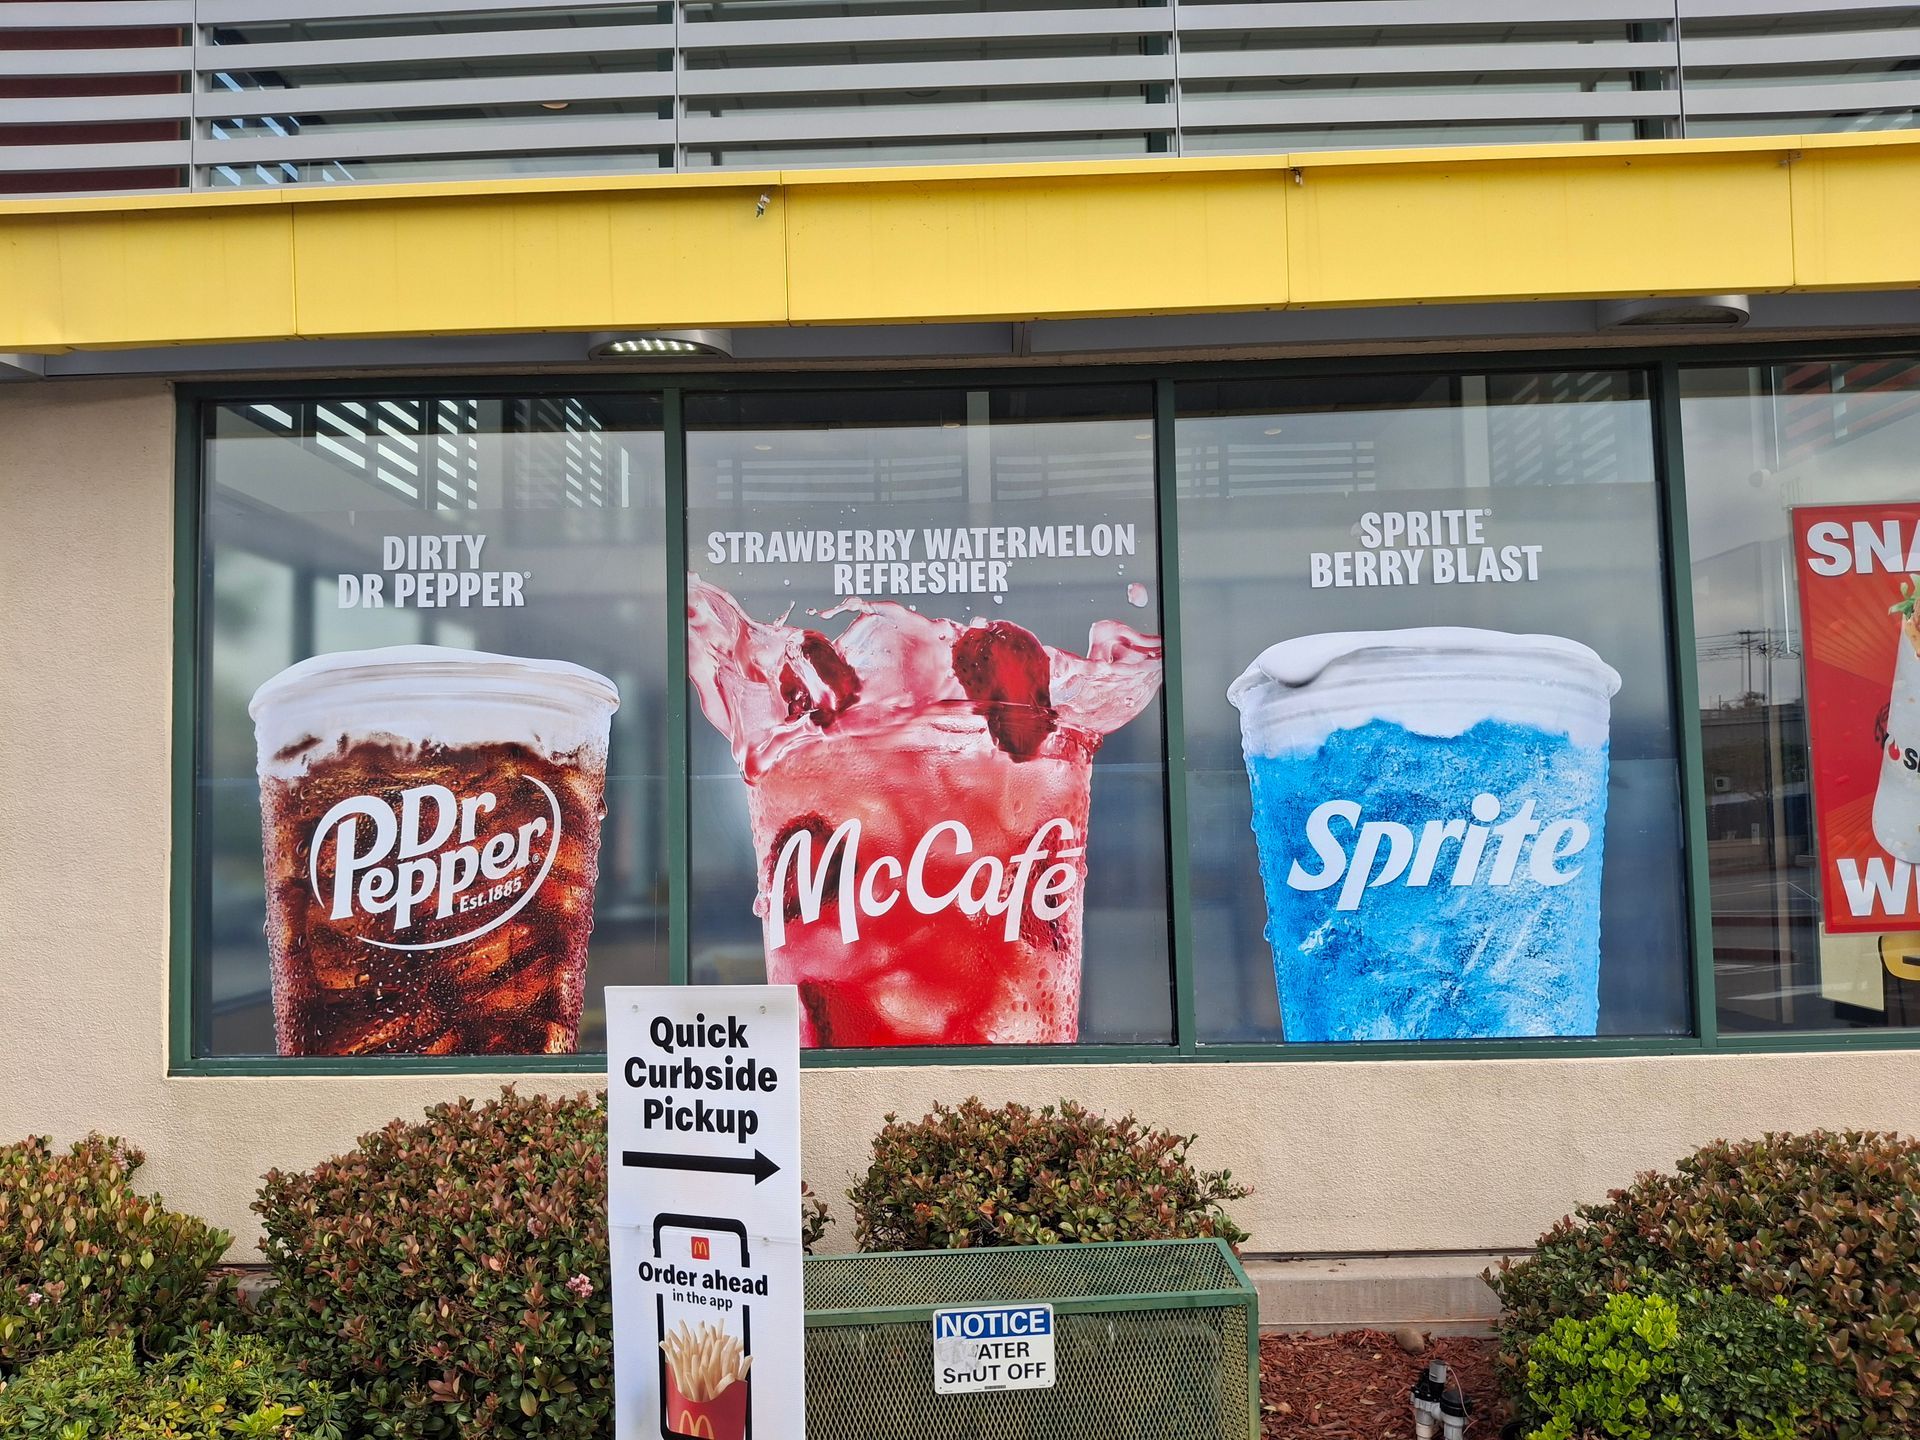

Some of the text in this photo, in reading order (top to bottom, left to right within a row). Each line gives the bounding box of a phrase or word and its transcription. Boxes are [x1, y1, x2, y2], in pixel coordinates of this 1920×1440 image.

[383, 535, 487, 570] DIRTY
[707, 524, 1135, 563] STRAWBERRY WATERMELON
[1311, 545, 1542, 588] BERRY BLAST
[338, 574, 384, 608] DR
[1903, 747, 1920, 773] S
[397, 784, 497, 860] Dr
[1287, 793, 1590, 911] Sprite
[769, 818, 1083, 951] McCafé
[1836, 857, 1920, 917] W
[650, 1013, 749, 1054] Quick
[624, 1055, 778, 1092] Curbside
[644, 1096, 759, 1144] Pickup
[638, 1261, 768, 1296] Order ahead
[672, 1288, 733, 1312] in the app
[941, 1310, 1046, 1338] NOTICE
[975, 1342, 1030, 1360] ATER
[1007, 1362, 1047, 1380] OFF
